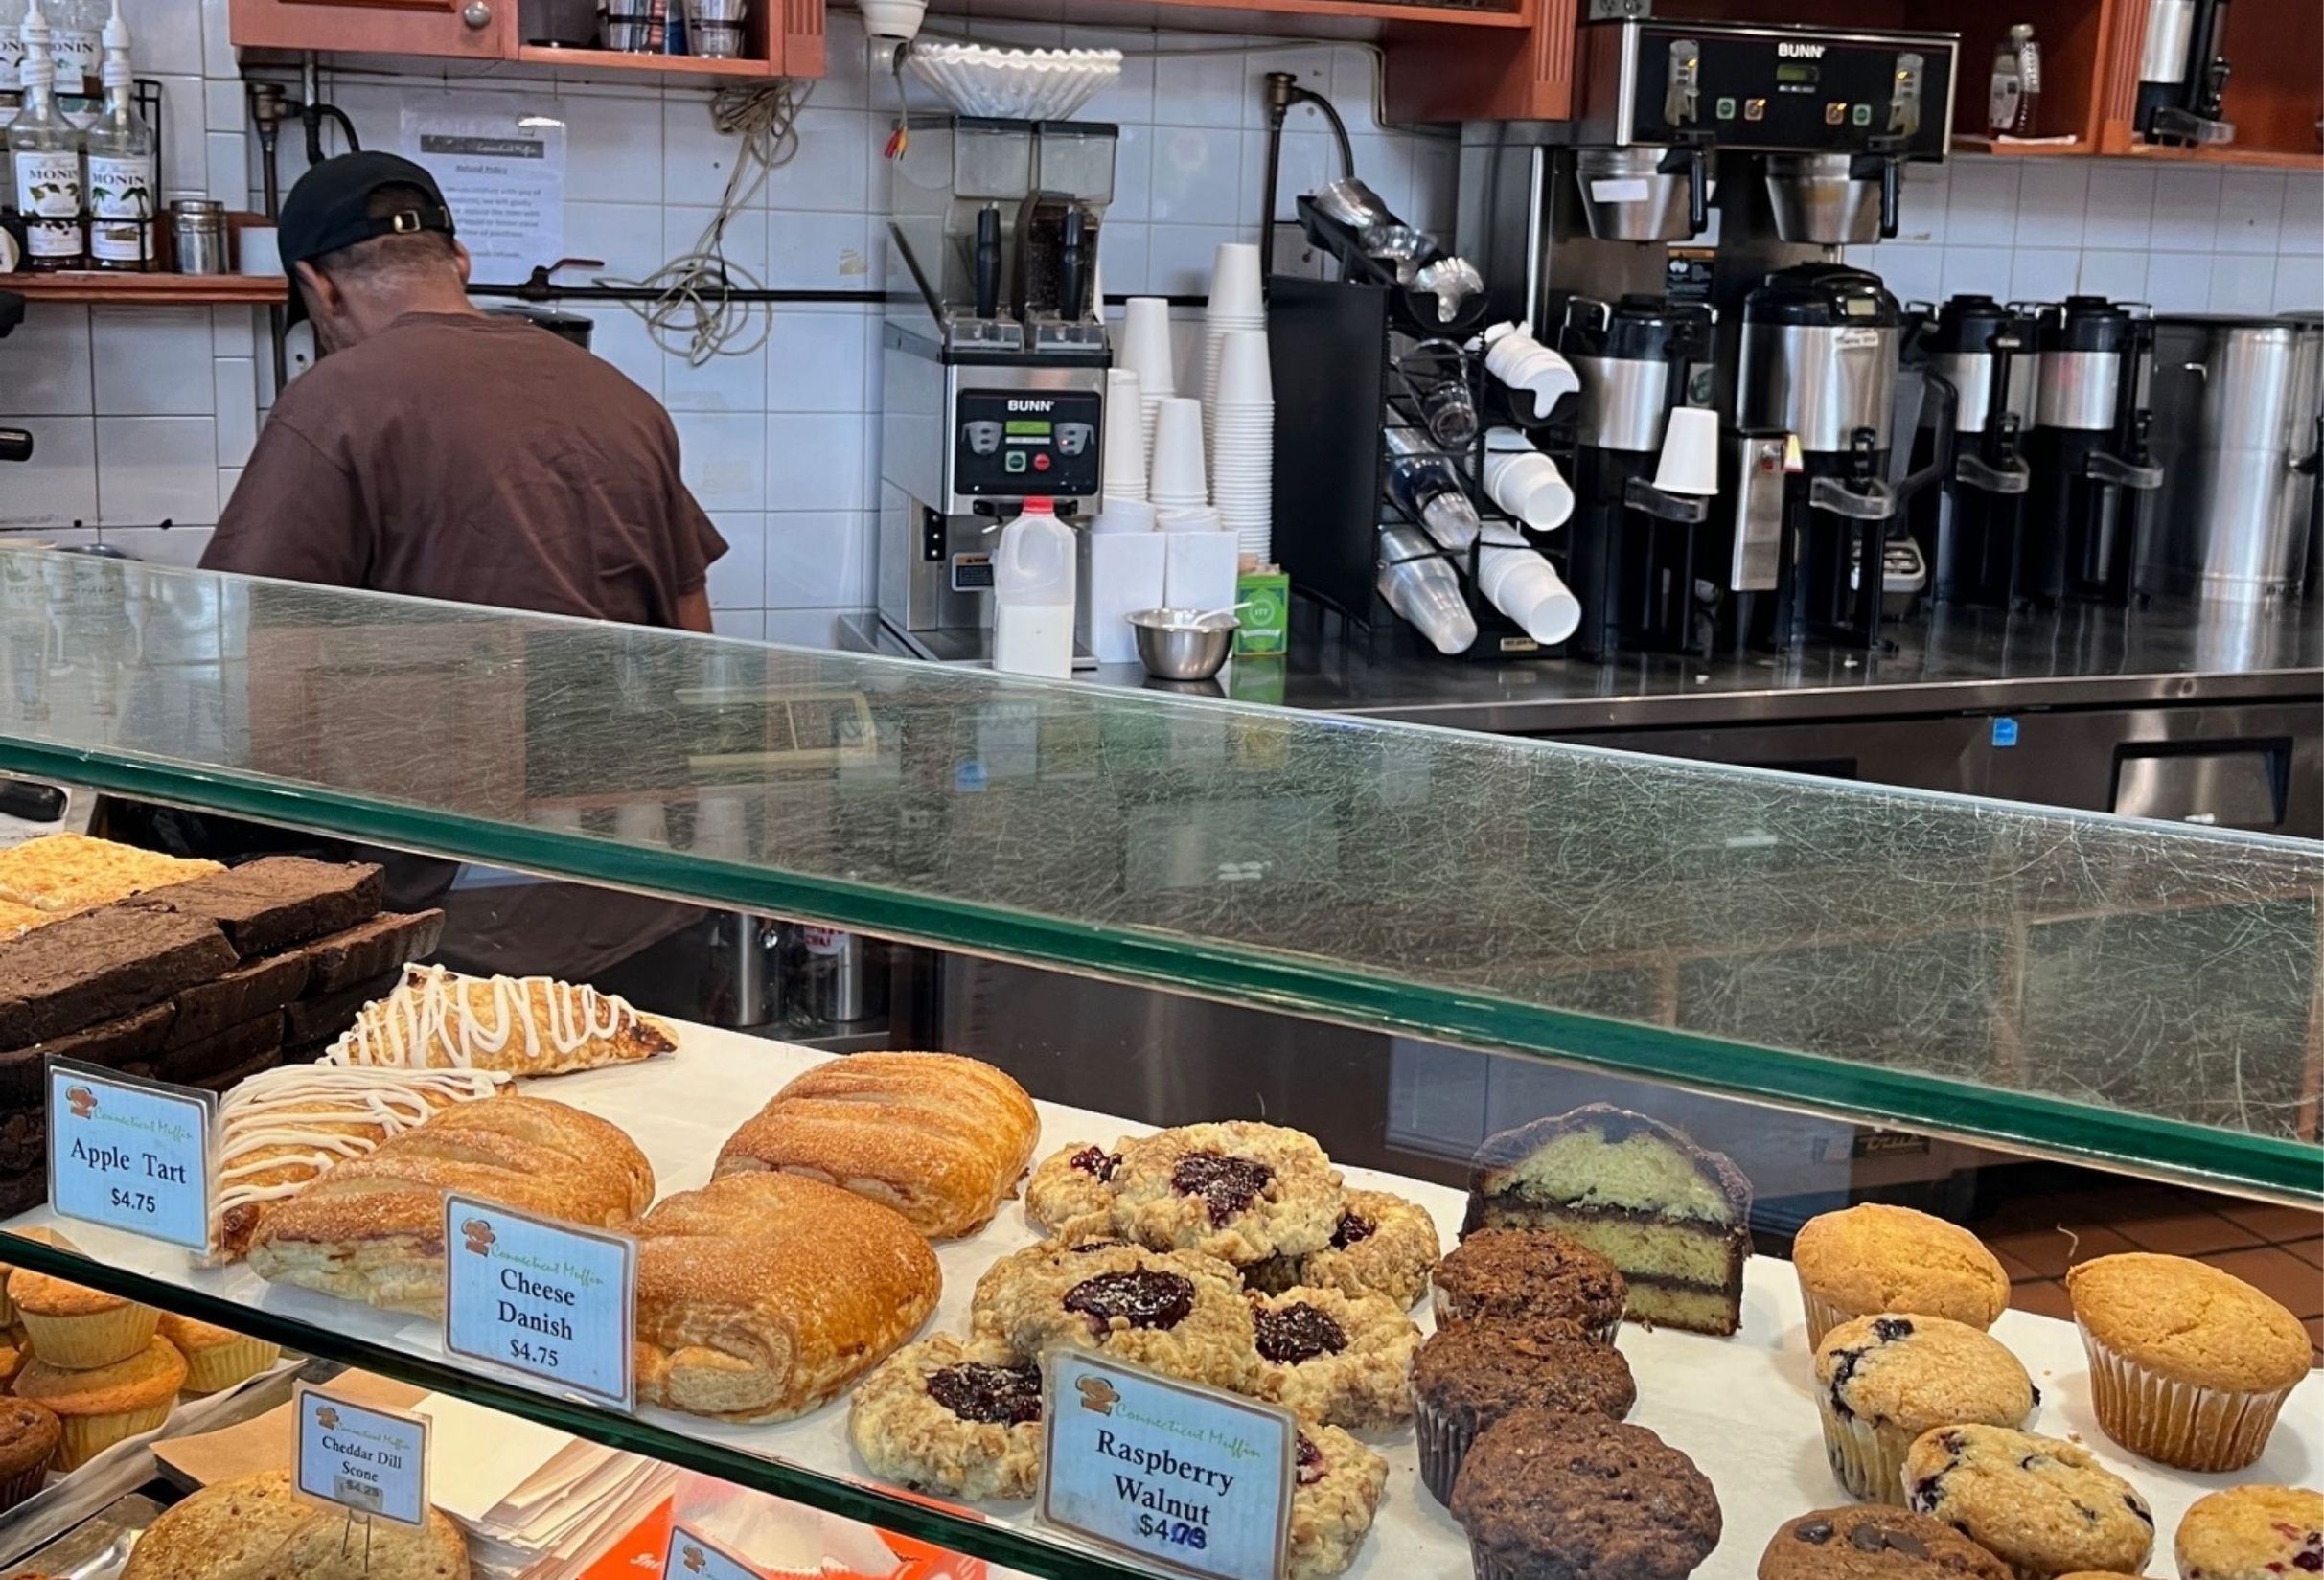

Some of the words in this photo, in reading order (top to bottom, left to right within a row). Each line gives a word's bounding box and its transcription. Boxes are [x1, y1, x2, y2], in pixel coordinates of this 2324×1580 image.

[53, 42, 94, 53] ONIN
[1778, 43, 1821, 58] BUNN
[92, 172, 145, 185] MONIN
[1007, 399, 1051, 412] BUNN
[95, 1106, 155, 1133] Connecticut
[158, 1120, 193, 1143] Muffin
[70, 1137, 130, 1173] Apple
[142, 1153, 187, 1184] Tart
[111, 1187, 157, 1213] $4.75
[491, 1246, 560, 1273] Connecticut
[564, 1261, 604, 1288] Muffin
[500, 1268, 576, 1306] Cheese
[498, 1300, 573, 1340] Danish
[510, 1339, 559, 1367] $4.75
[1115, 1403, 1204, 1442] Connecticut
[1209, 1431, 1261, 1459] Muffin
[322, 1435, 374, 1461] Cheddar
[378, 1452, 403, 1469] Dill
[1096, 1428, 1234, 1497] Raspberry
[342, 1460, 379, 1482] Scone
[1113, 1473, 1211, 1527] Walnut
